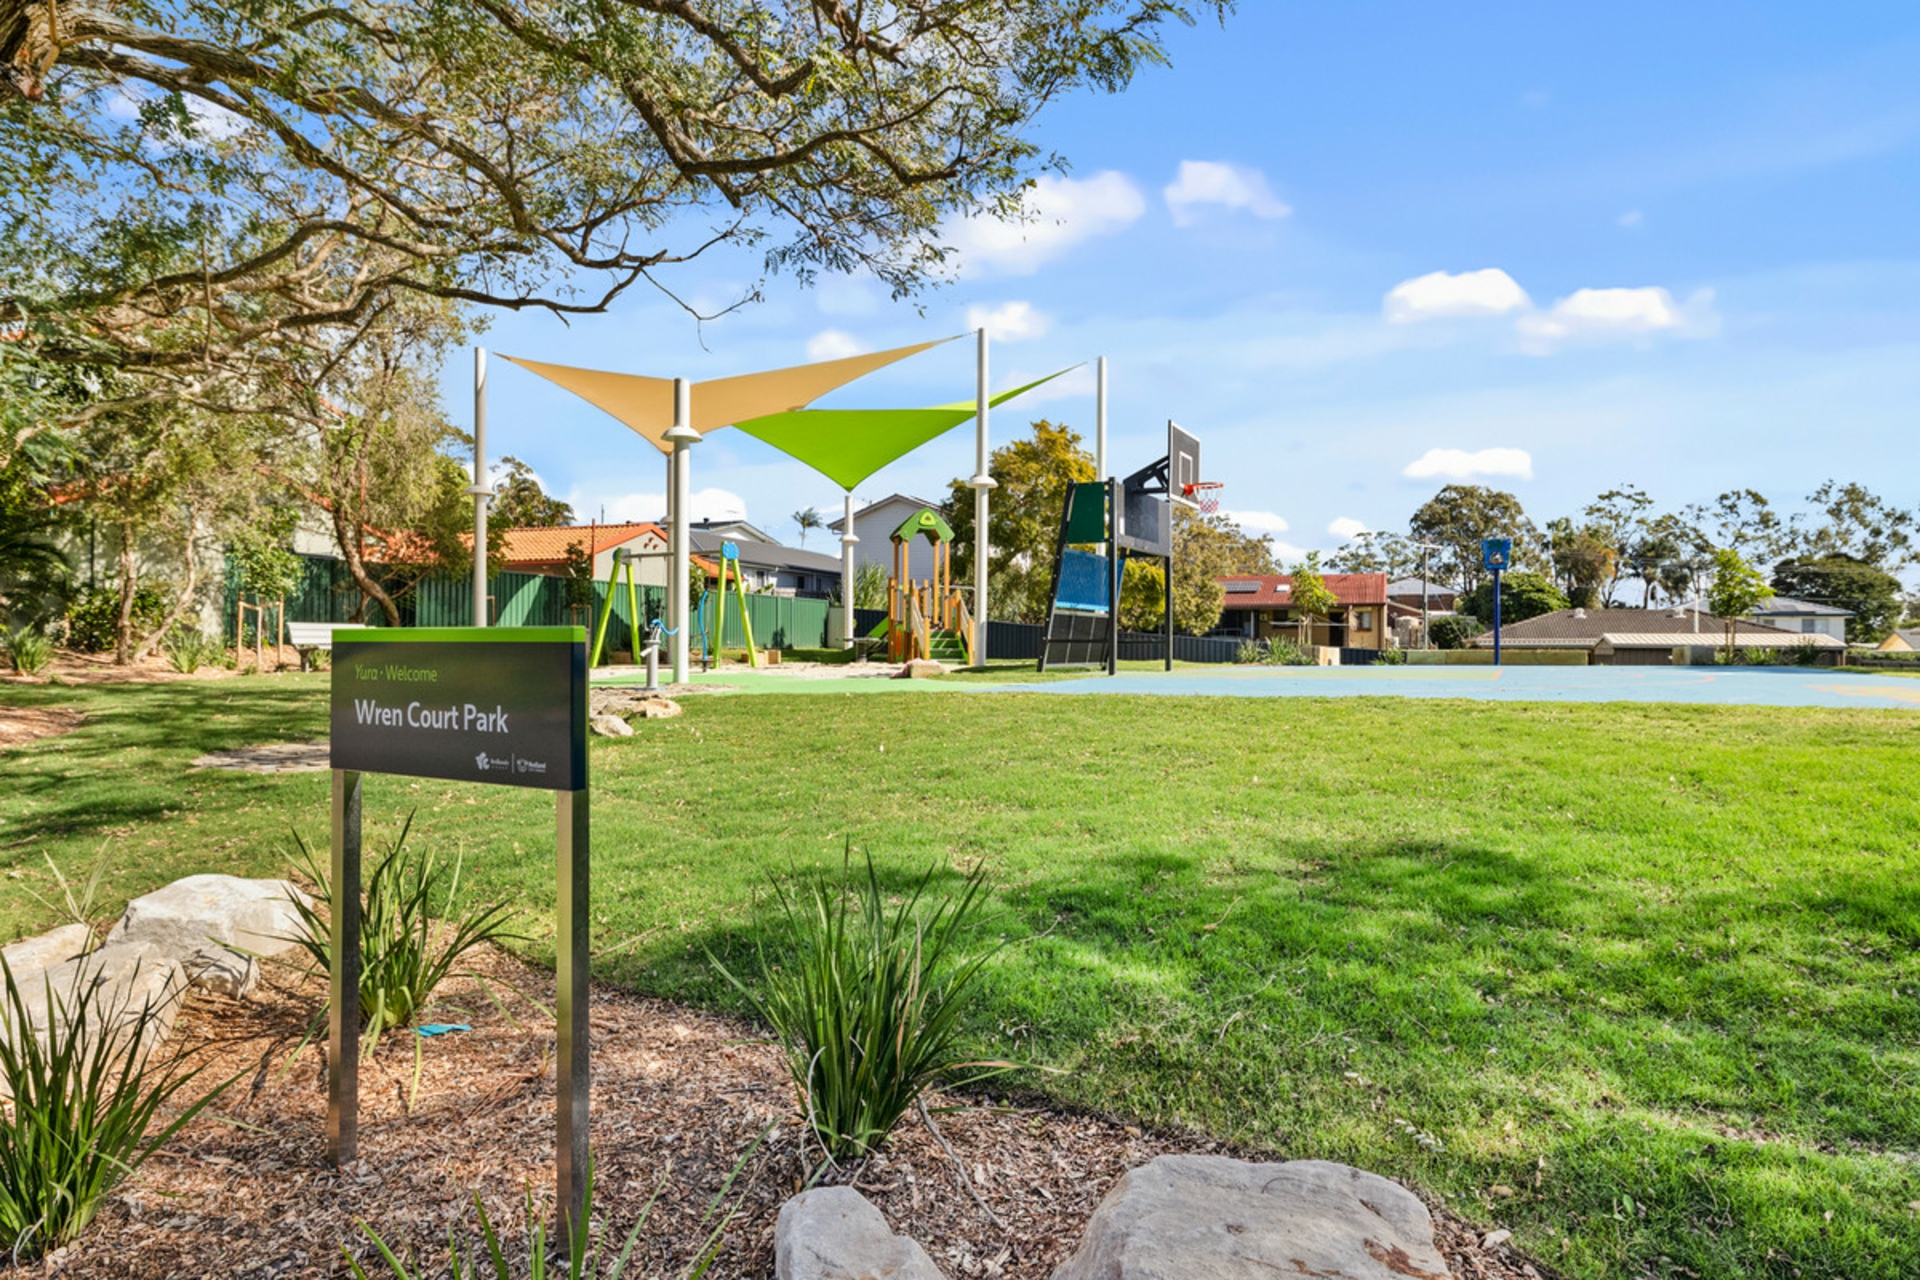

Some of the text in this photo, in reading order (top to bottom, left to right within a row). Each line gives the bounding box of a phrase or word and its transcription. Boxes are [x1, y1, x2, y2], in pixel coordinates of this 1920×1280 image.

[355, 664, 438, 682] Yura Welcome
[354, 699, 509, 733] Wren Court Park
